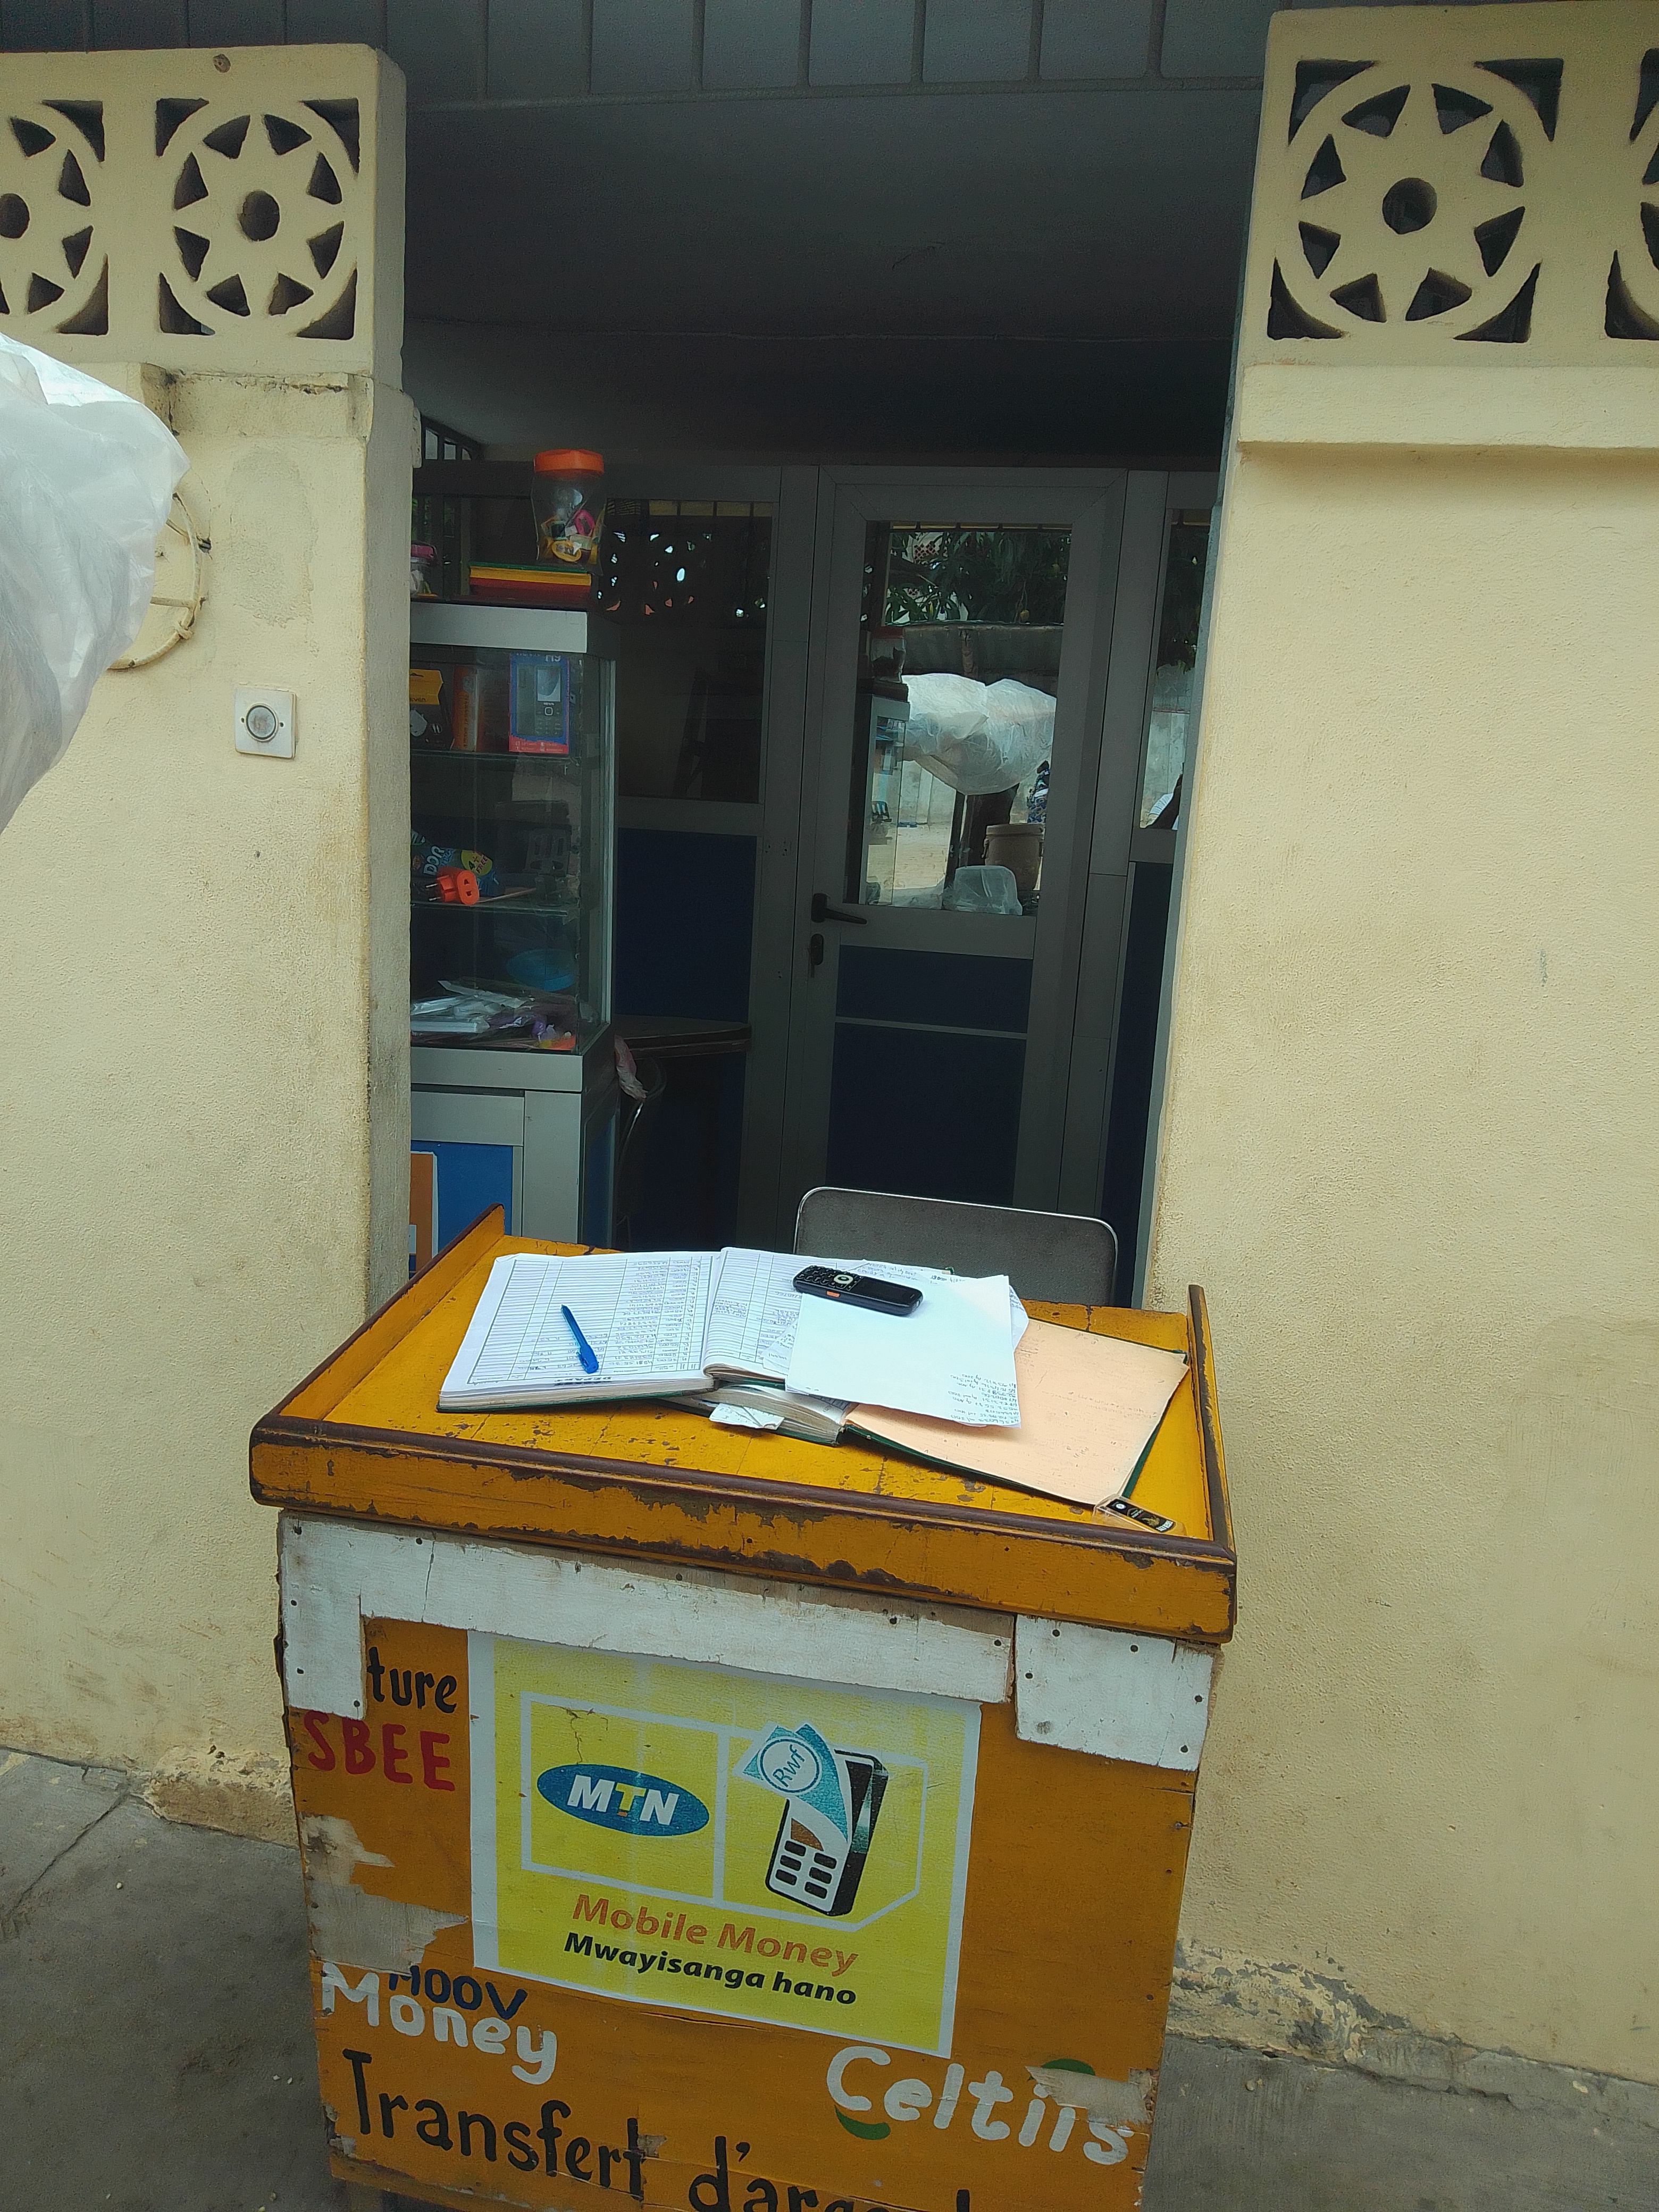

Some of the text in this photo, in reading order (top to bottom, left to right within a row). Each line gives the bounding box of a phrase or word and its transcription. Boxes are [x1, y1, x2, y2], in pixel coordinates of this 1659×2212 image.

[476, 856, 488, 874] FREE
[367, 1646, 457, 1714] ture
[303, 1710, 456, 1791] SBEE
[772, 1744, 809, 1789] Rwf
[567, 1774, 681, 1826] MTN
[565, 1932, 857, 2005] Mwayisanga hano
[572, 1894, 859, 1976] Mobile Money
[322, 1961, 557, 2085] Money
[342, 2048, 646, 2201] Transfert
